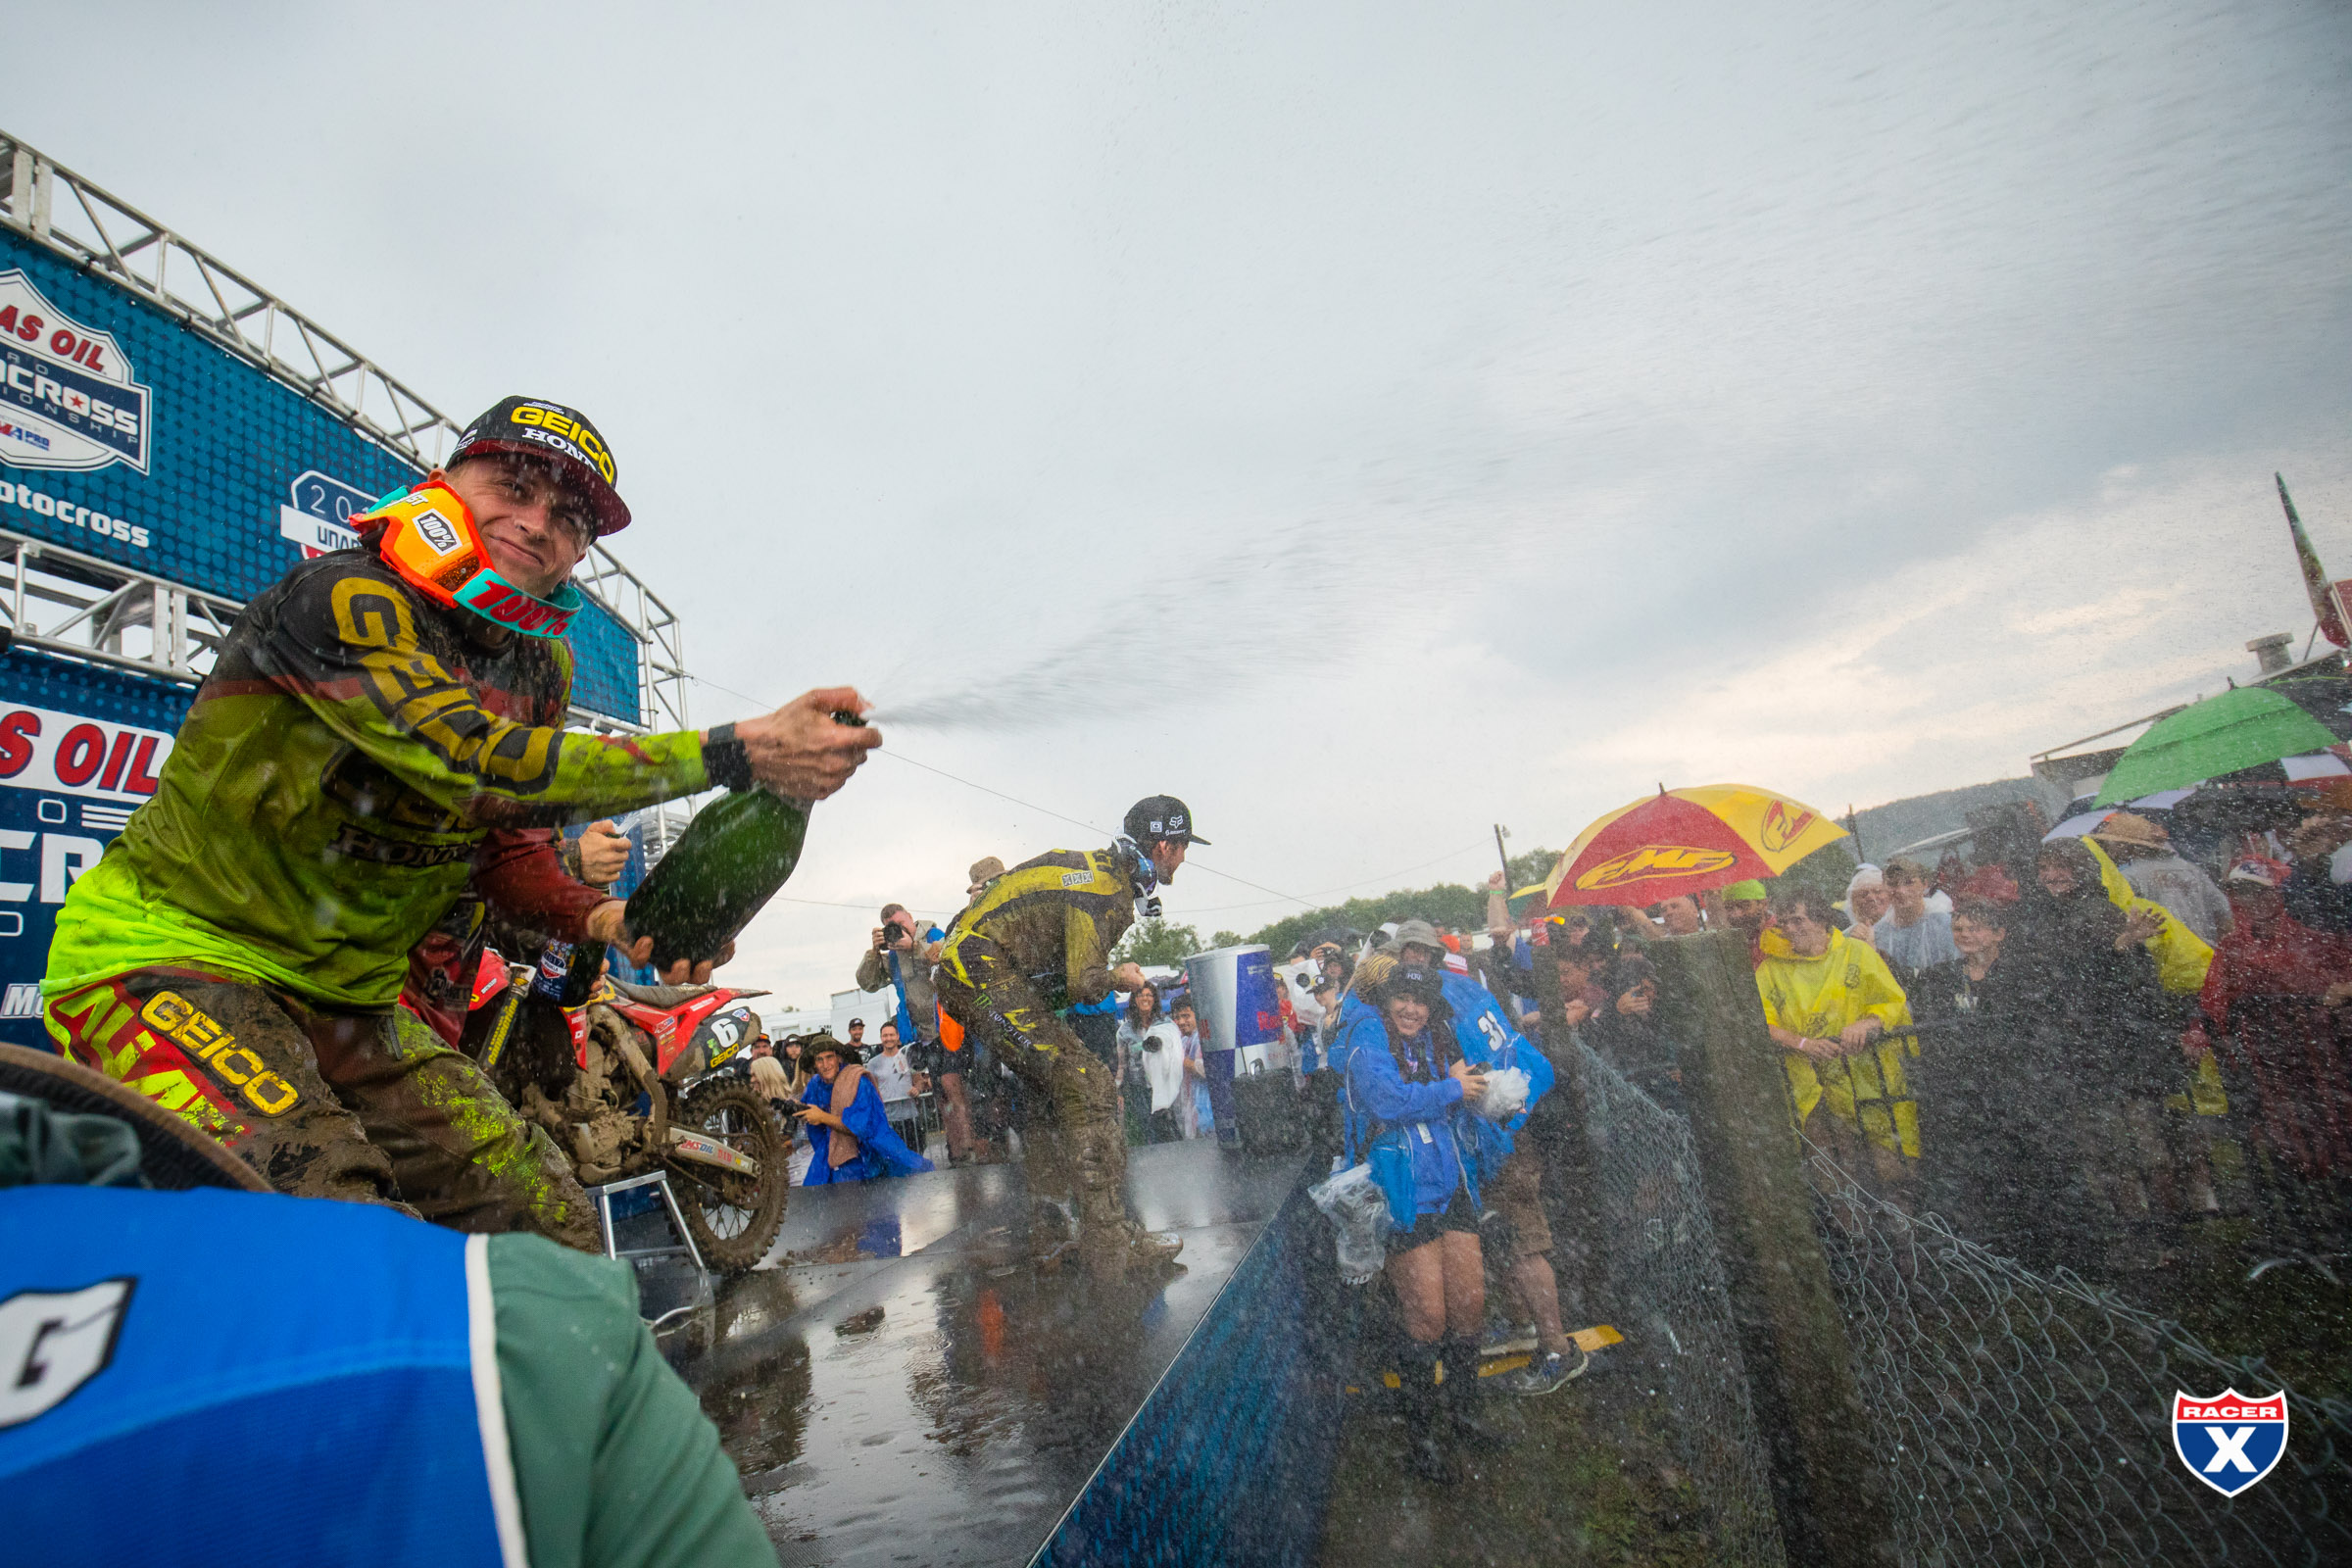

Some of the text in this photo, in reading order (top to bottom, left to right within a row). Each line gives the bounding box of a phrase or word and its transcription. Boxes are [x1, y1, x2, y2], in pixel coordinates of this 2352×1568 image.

[50, 329, 105, 372] OIL
[0, 359, 138, 435] CROSS
[511, 406, 614, 484] GEICO
[521, 427, 602, 476] HON
[0, 480, 149, 548] otocross
[419, 515, 456, 548] 100%
[467, 579, 573, 635] 100%
[54, 723, 161, 797] OIL
[141, 991, 298, 1114] GEICO
[710, 1043, 739, 1068] GEICO
[711, 1018, 739, 1048] 6
